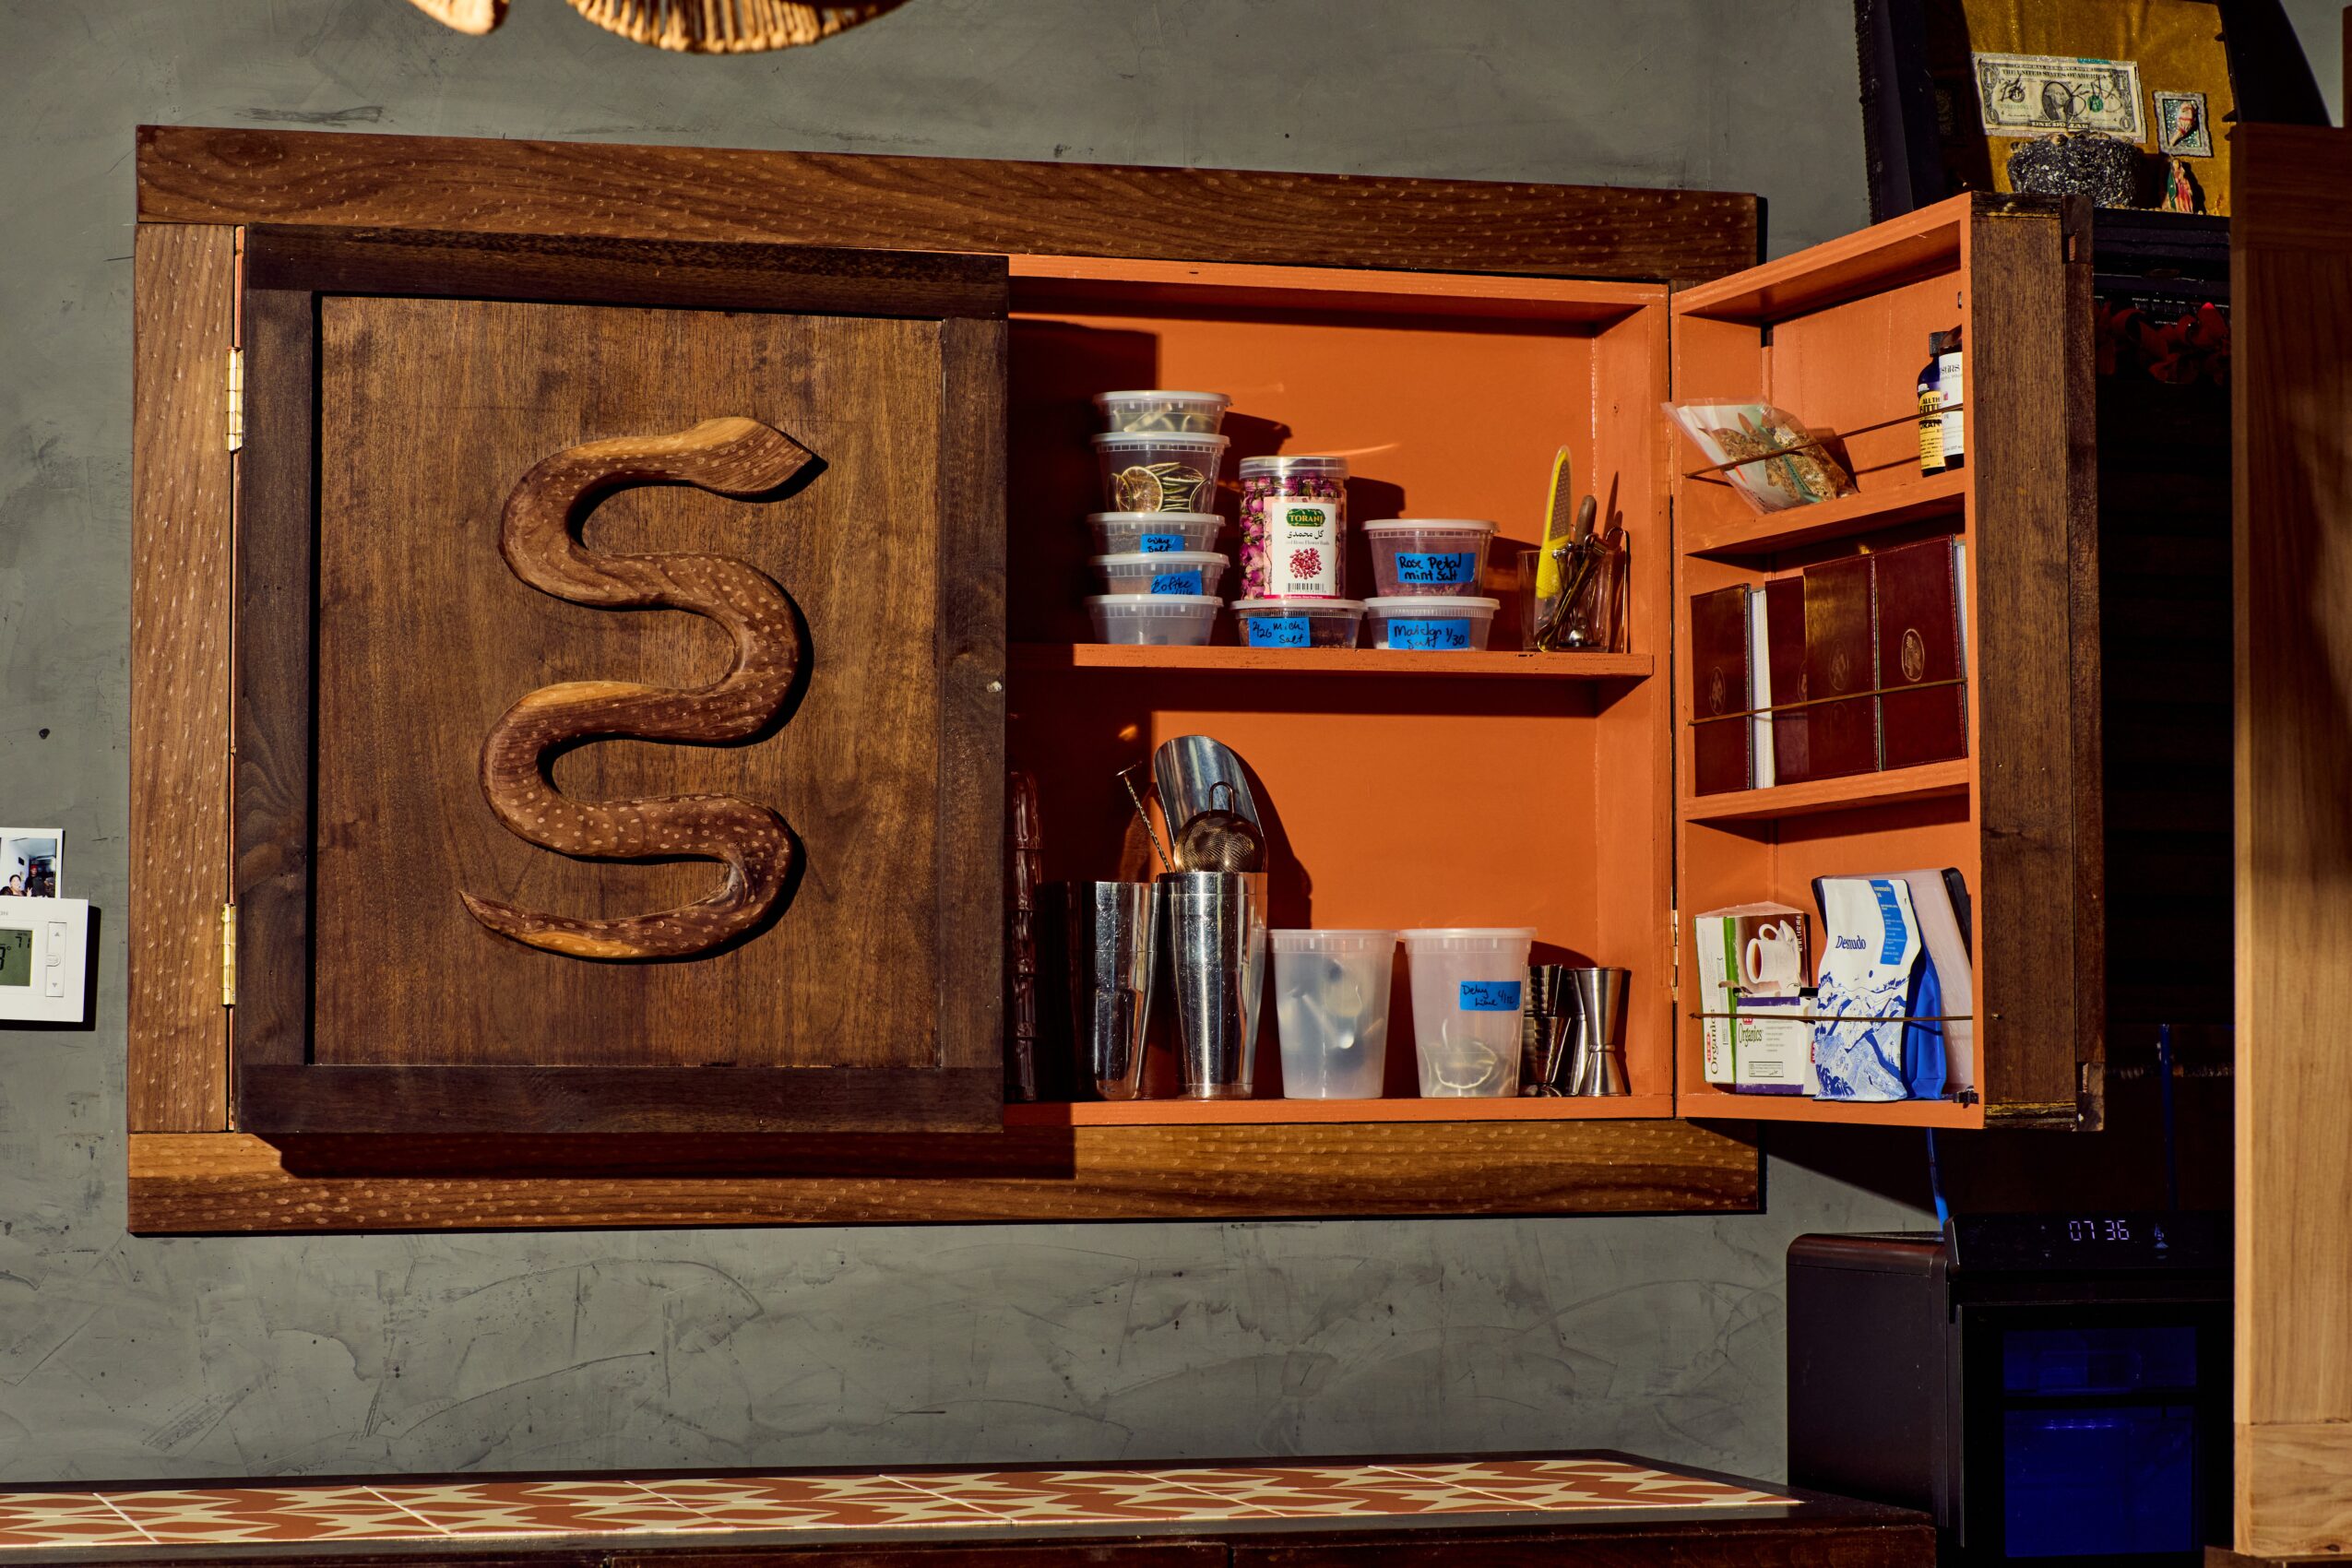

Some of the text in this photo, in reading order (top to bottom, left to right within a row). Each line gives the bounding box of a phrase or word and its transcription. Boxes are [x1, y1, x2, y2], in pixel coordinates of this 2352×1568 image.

[1398, 552, 1462, 571] Rose Petal
[1405, 569, 1433, 581] mint
[1738, 1022, 1764, 1048] Organics
[2069, 1219, 2130, 1241] 07 36
